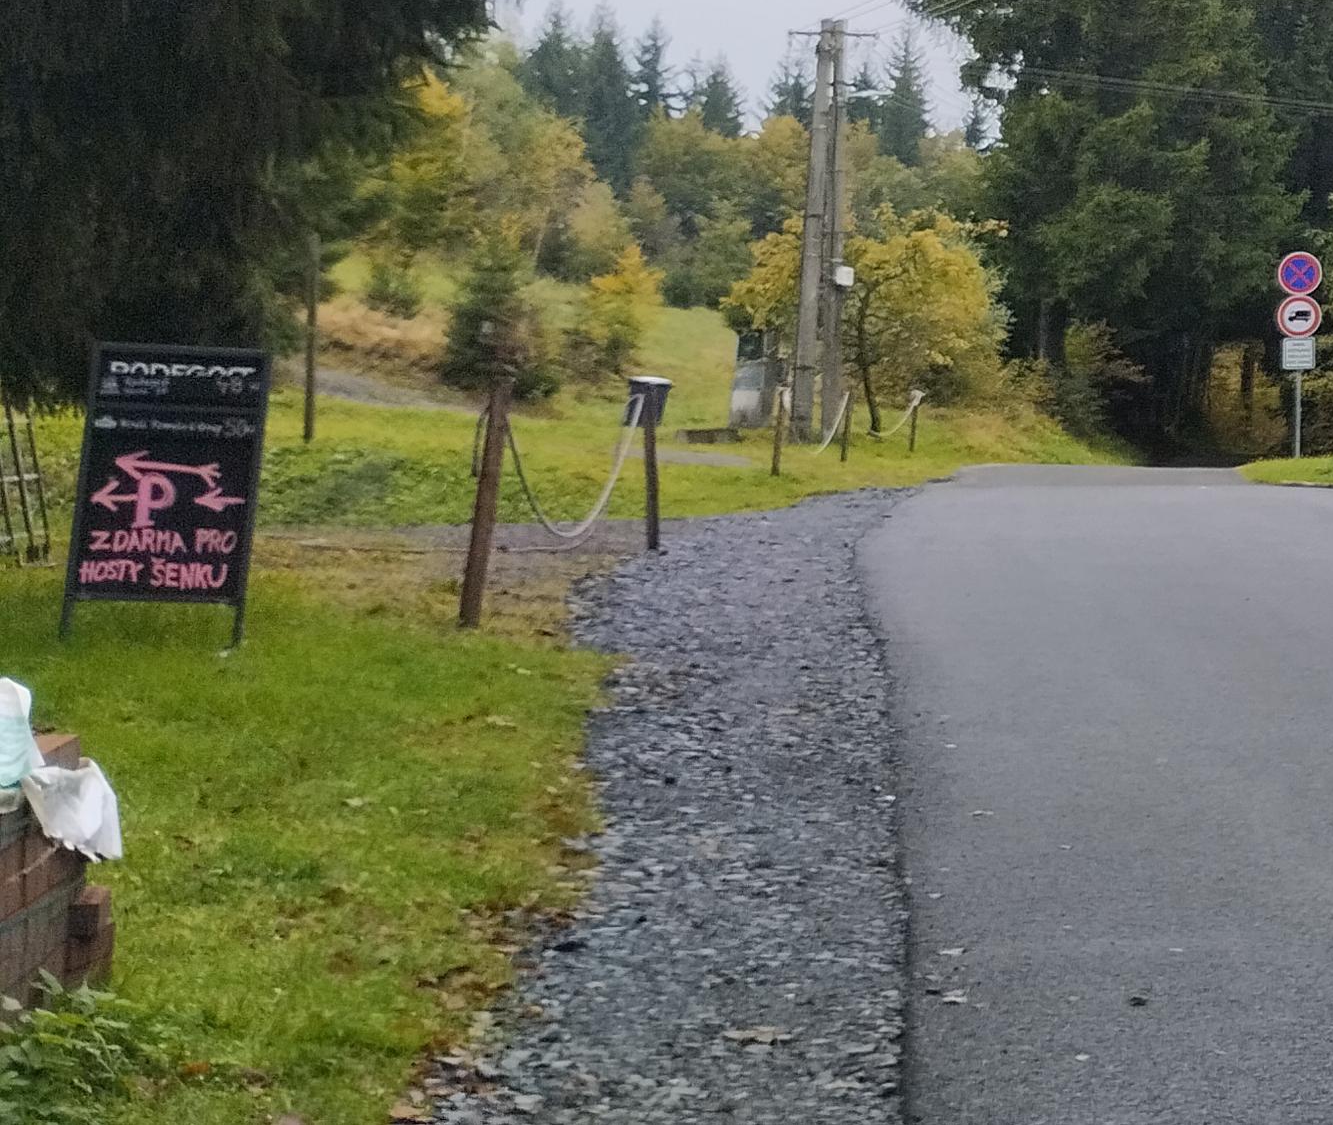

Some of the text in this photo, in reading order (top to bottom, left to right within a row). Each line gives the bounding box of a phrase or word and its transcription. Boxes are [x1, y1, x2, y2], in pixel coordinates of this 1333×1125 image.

[133, 473, 176, 528] P
[89, 529, 238, 554] ZDARMA PRO
[78, 557, 228, 589] HOSTY ŠENKU
